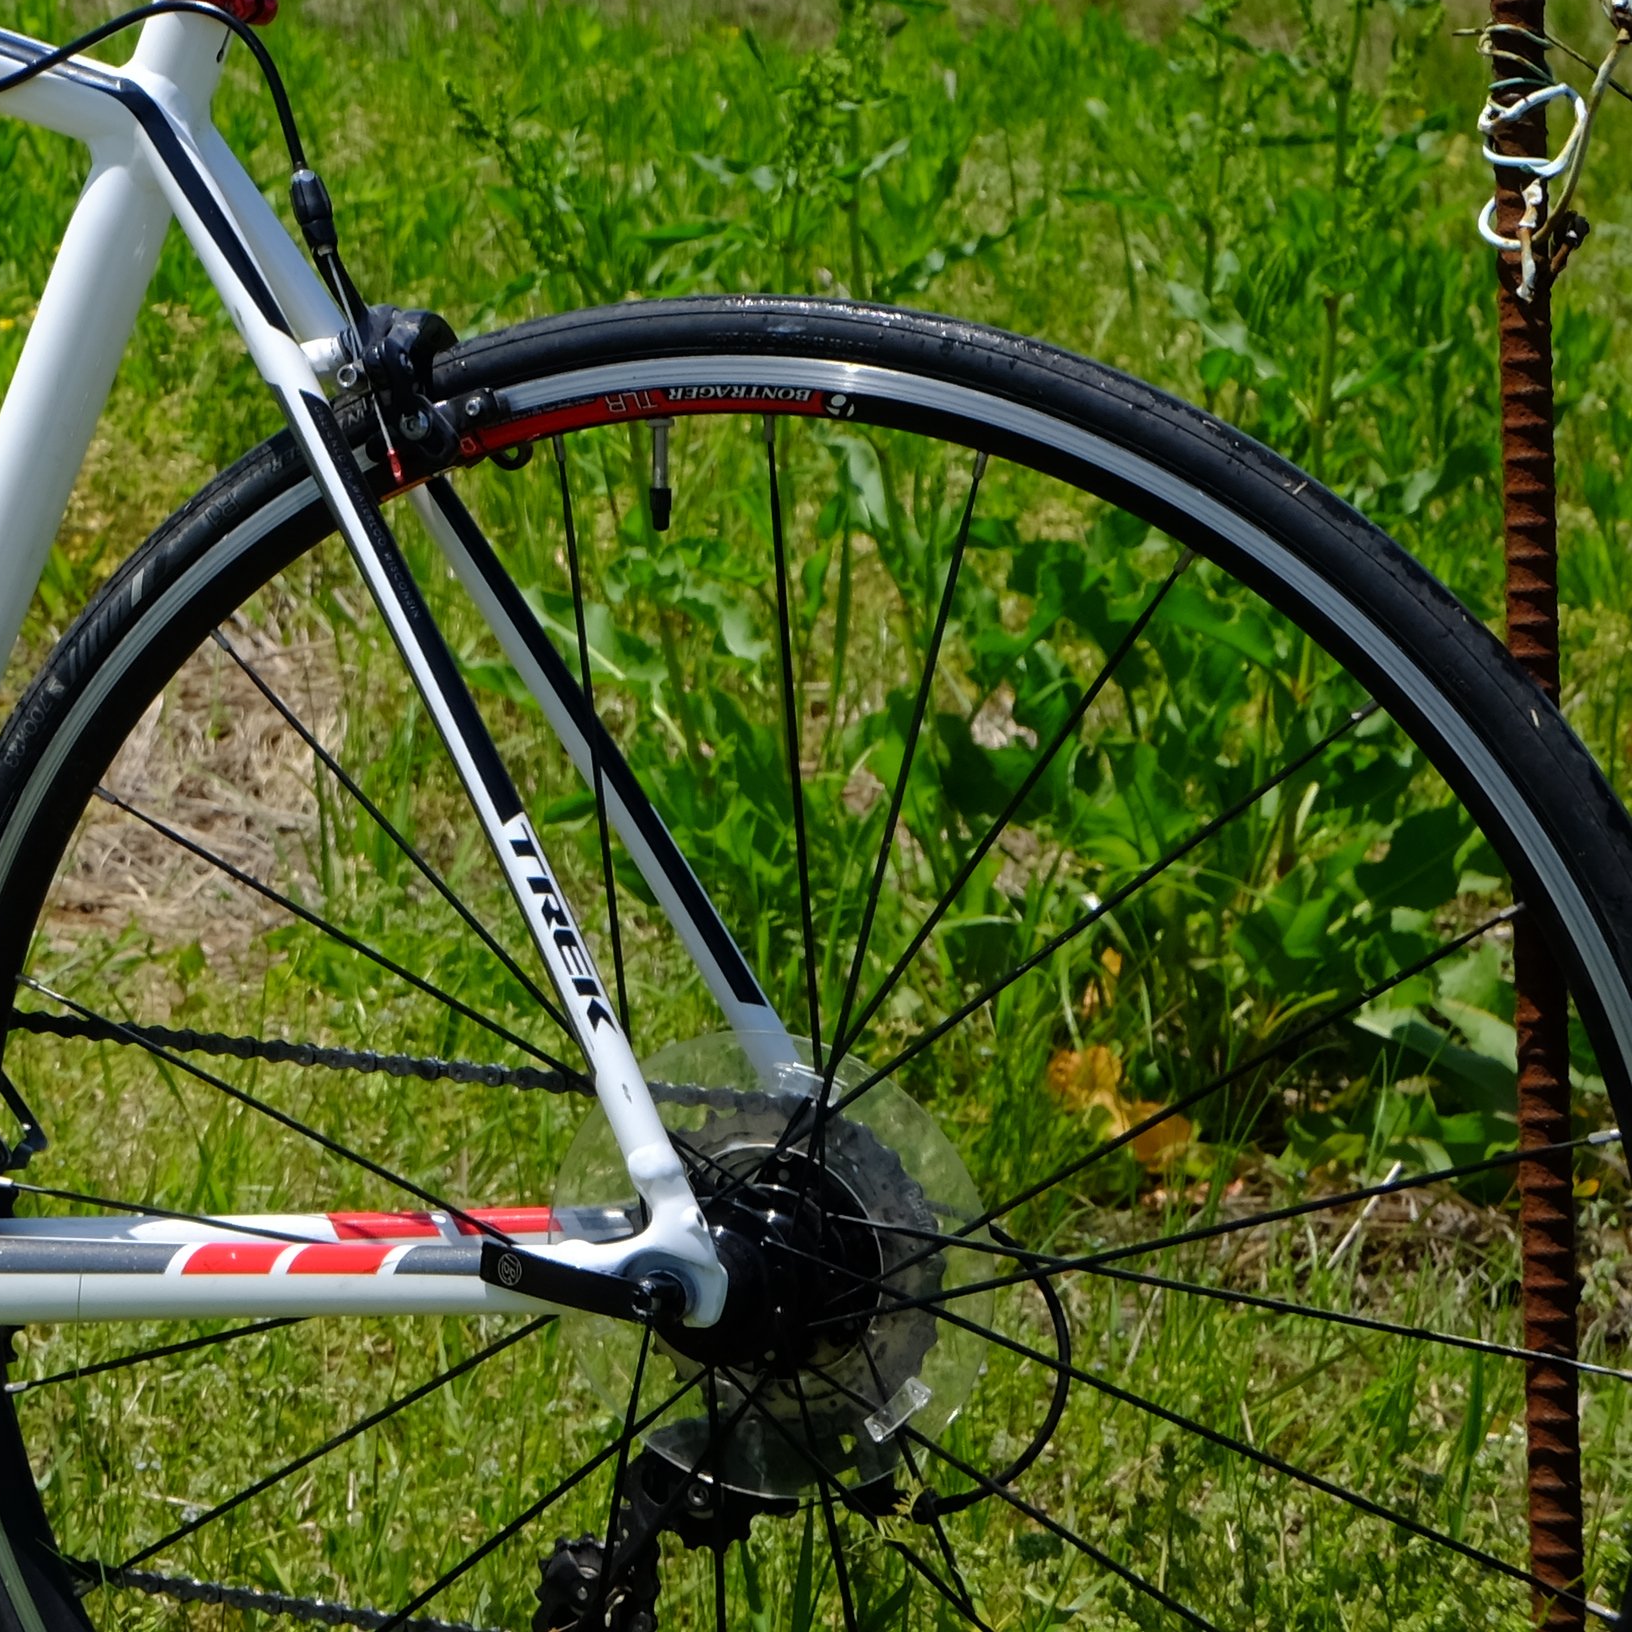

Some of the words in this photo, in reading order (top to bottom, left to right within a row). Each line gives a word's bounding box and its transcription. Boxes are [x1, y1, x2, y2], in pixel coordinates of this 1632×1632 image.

[604, 390, 658, 414] TLR
[668, 385, 817, 403] BONTRAGER
[383, 551, 422, 619] WISCONSIN
[509, 822, 619, 1034] TREK
